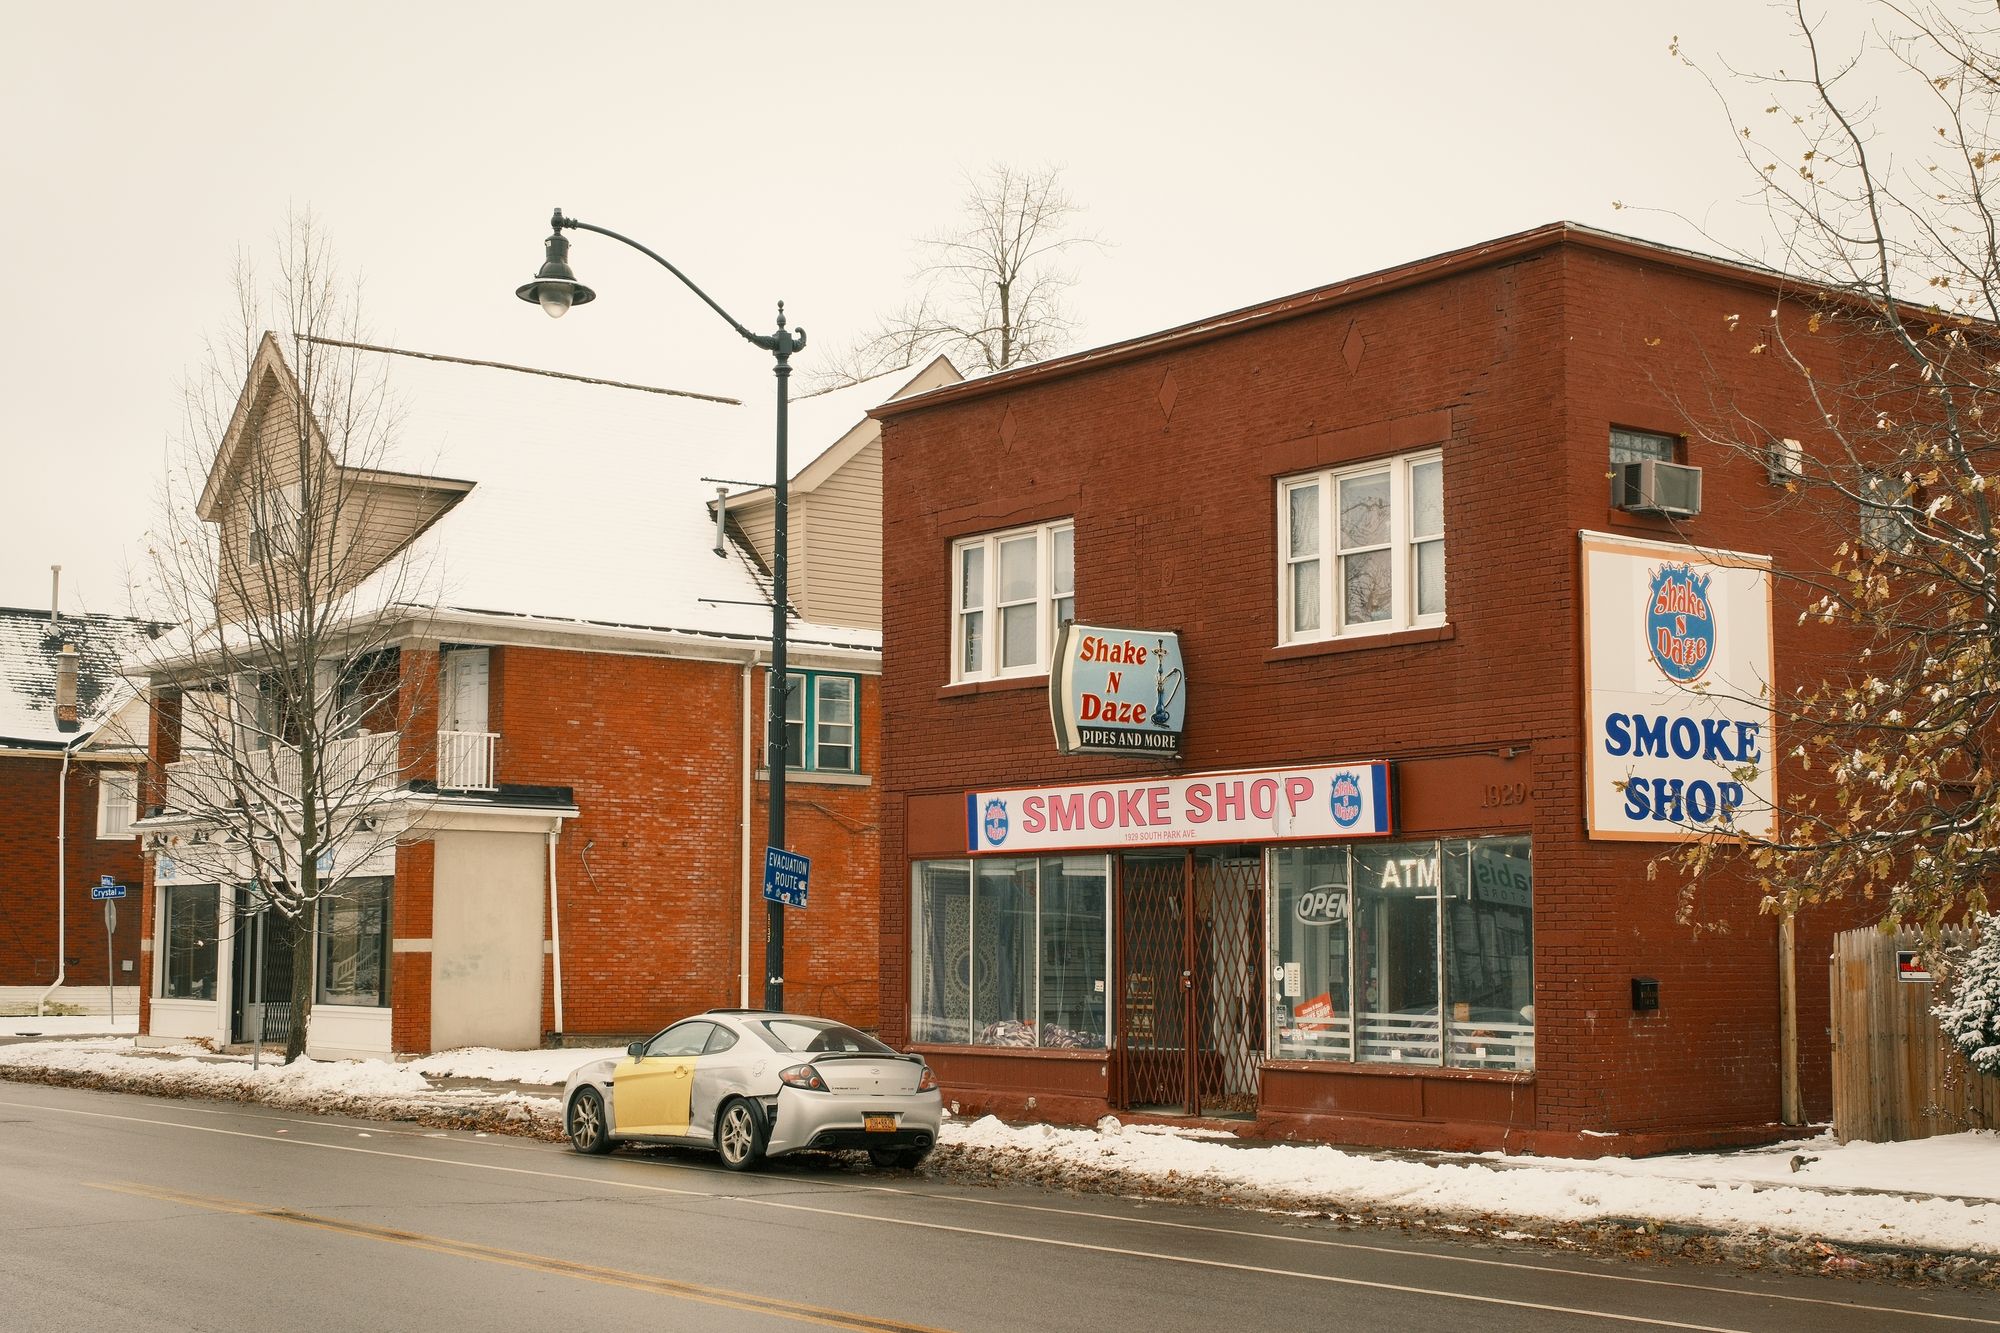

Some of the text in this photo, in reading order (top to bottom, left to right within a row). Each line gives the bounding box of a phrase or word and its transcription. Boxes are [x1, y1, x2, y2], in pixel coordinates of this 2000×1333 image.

[1654, 576, 1707, 620] Shake
[1079, 635, 1148, 665] Shake
[1656, 626, 1707, 667] Daze
[1106, 671, 1122, 694] N
[1080, 693, 1147, 724] Daze
[1082, 730, 1176, 748] PIPES AND MORE
[1604, 712, 1762, 764] SMOKE
[1022, 776, 1315, 834] SMOKE SHOP
[1481, 783, 1527, 808] 1929
[1624, 775, 1744, 823] SHOP
[1124, 833, 1138, 841] 1929
[1139, 831, 1162, 841] SOUTH
[1163, 830, 1181, 839] PARK
[769, 852, 808, 876] EVACUATION
[1380, 860, 1438, 889] ATM
[93, 889, 117, 898] Crystal
[774, 871, 799, 890] ROUTE
[1299, 892, 1348, 918] OPEN
